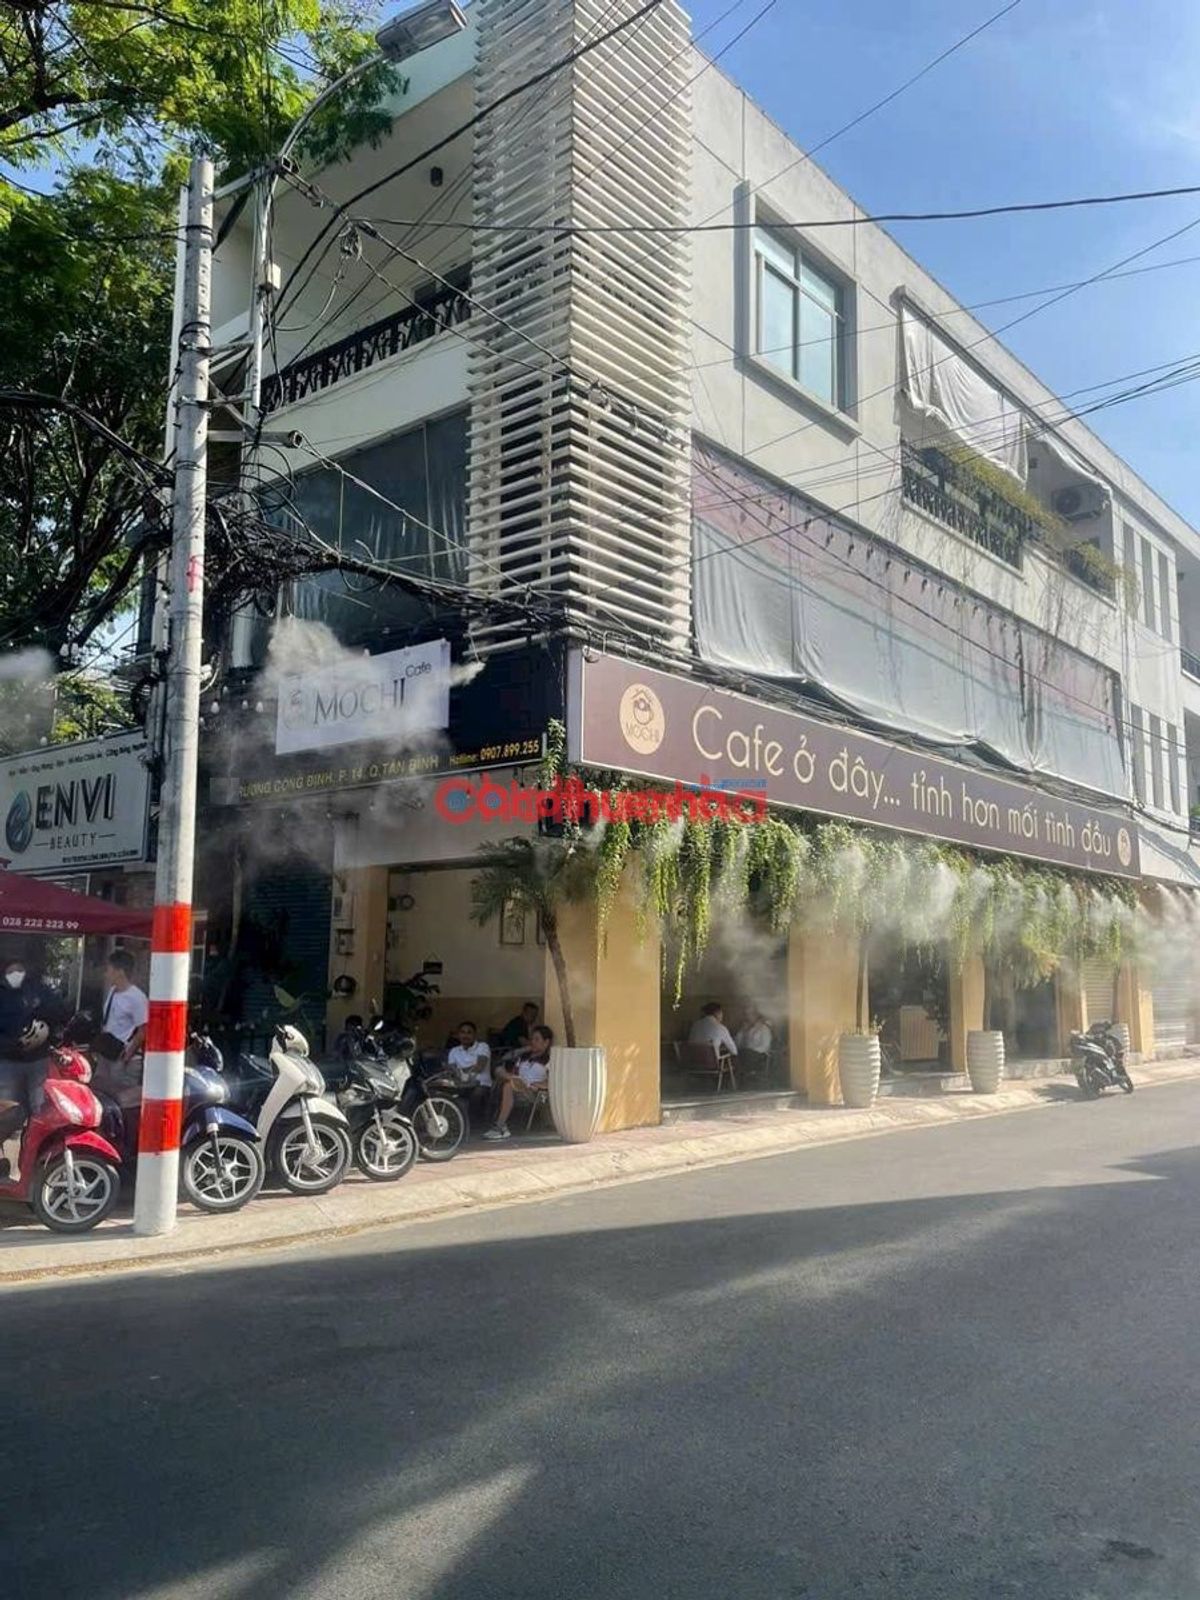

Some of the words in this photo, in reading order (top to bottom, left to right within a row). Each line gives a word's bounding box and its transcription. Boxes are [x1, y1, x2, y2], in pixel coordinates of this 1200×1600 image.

[405, 662, 432, 678] Cafe
[313, 677, 406, 725] MOCHI
[692, 705, 785, 776] Cafe
[793, 734, 816, 784] ở
[828, 747, 900, 810] đây...
[910, 770, 953, 819] tỉnh
[962, 782, 1001, 831] hơn
[1007, 801, 1039, 841] mối
[1044, 811, 1075, 849] tình
[35, 773, 116, 831] ENVI
[50, 832, 98, 850] BEAUTY
